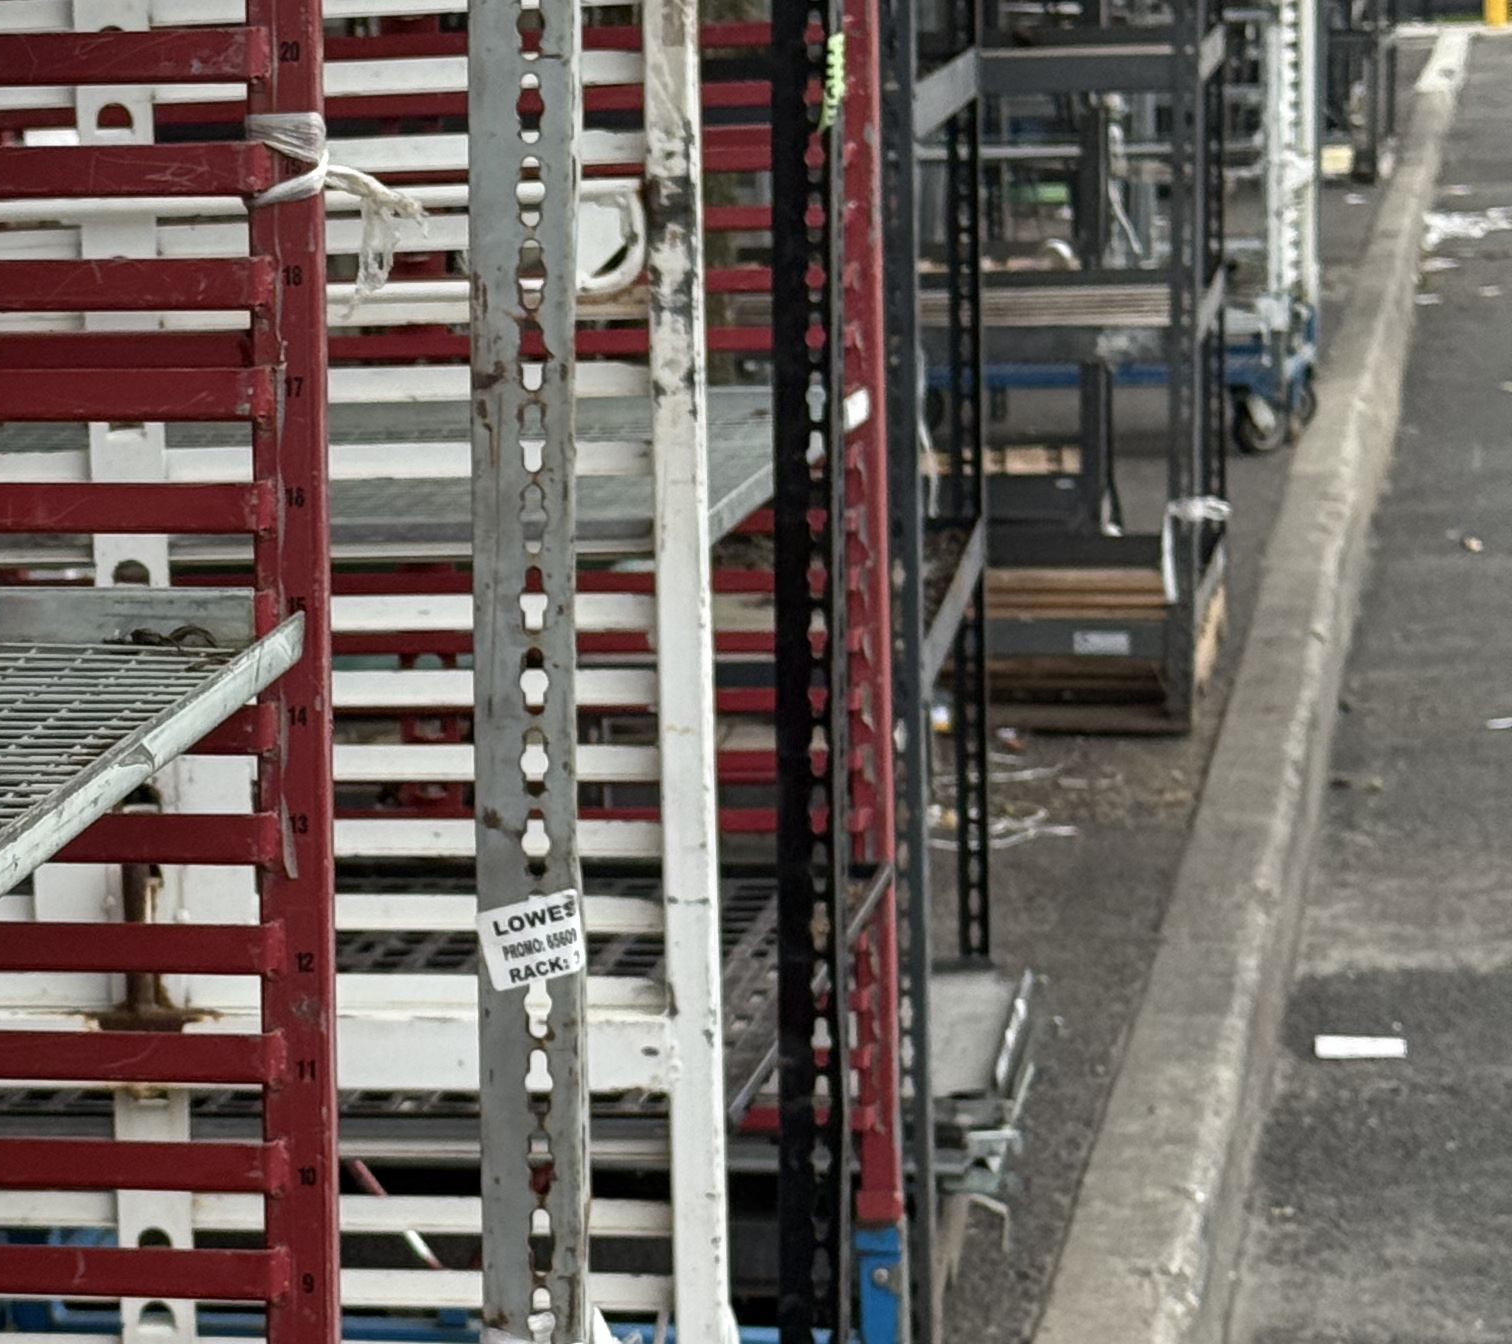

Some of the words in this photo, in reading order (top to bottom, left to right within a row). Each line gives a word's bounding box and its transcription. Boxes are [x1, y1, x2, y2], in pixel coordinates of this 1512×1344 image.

[280, 41, 300, 62] 20
[283, 266, 302, 286] 18
[285, 377, 303, 397] 17
[288, 707, 307, 725] 14
[289, 814, 308, 834] 13
[493, 899, 577, 937] LOWES
[502, 937, 547, 961] PROMO:
[296, 953, 313, 972] 12
[509, 956, 571, 984] RACK:
[297, 1060, 315, 1079] 11
[299, 1168, 316, 1186] 10
[303, 1274, 314, 1293] 9
